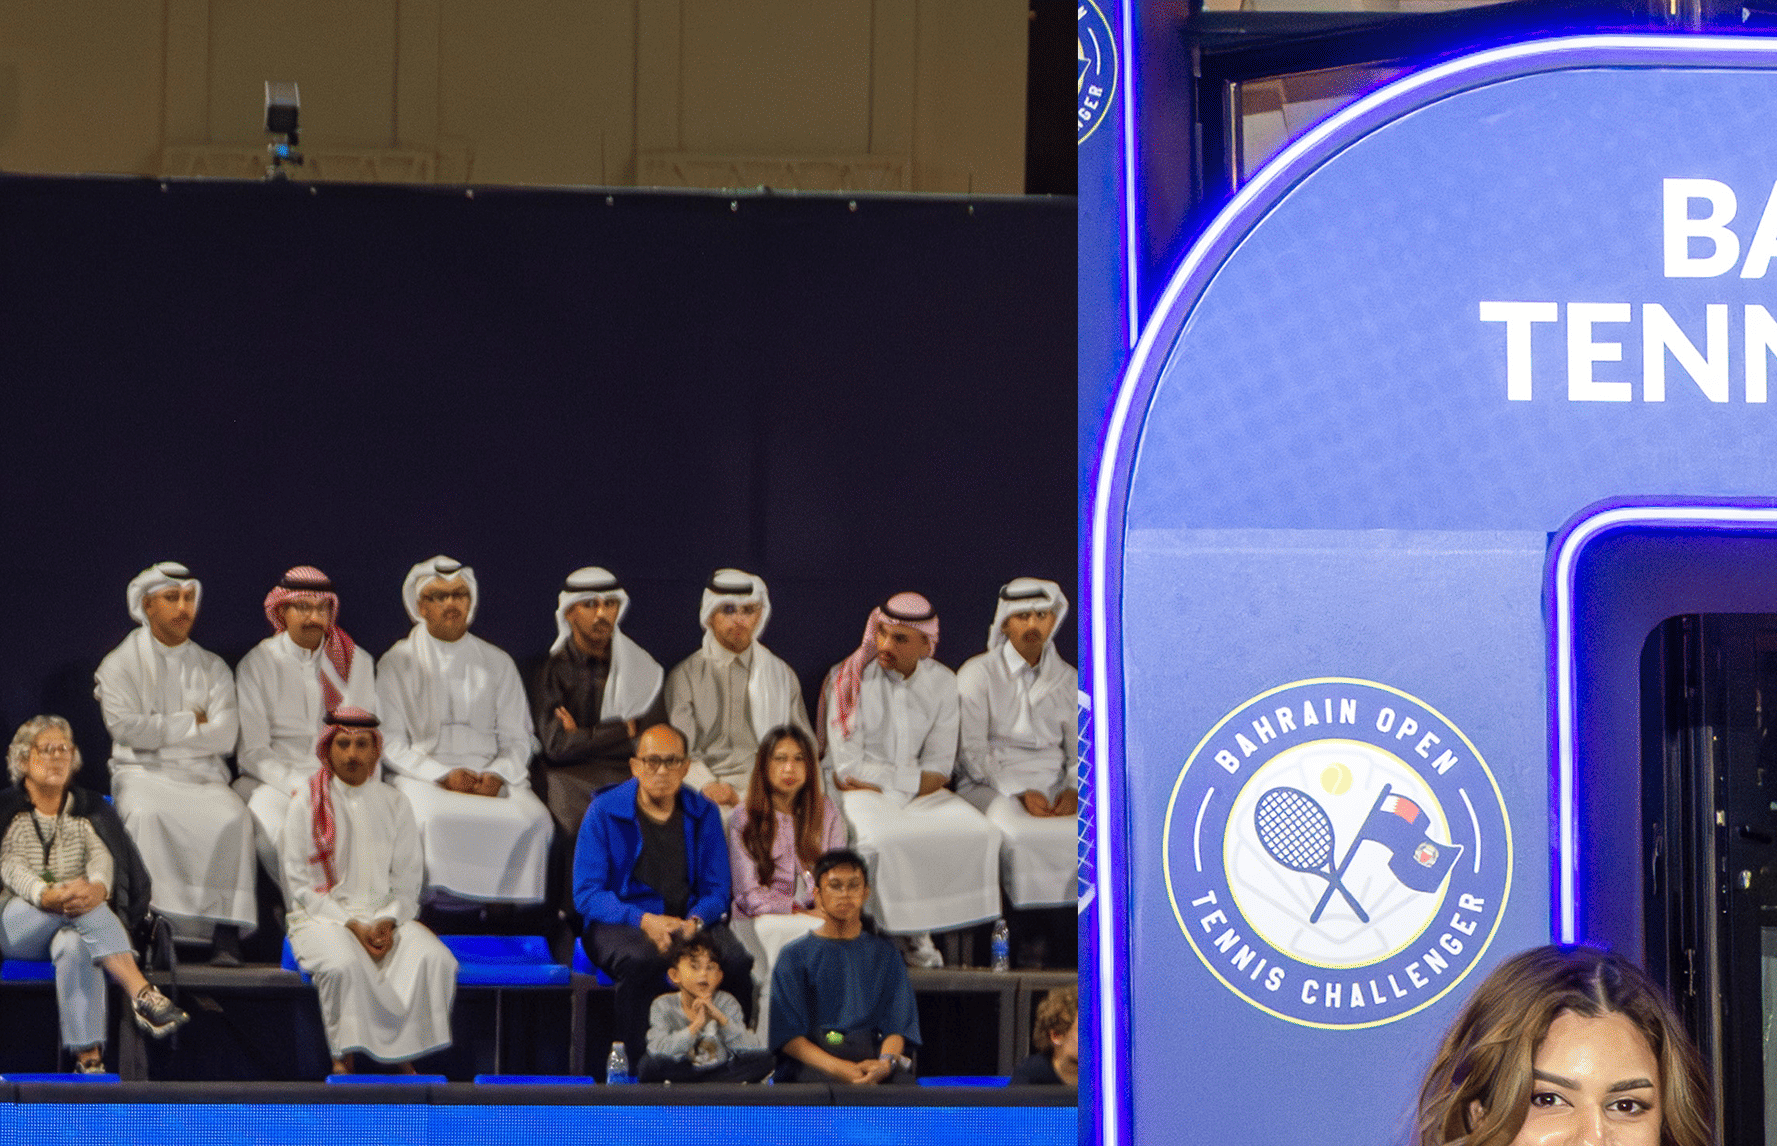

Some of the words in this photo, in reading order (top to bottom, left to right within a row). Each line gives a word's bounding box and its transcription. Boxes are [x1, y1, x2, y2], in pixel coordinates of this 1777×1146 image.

[1214, 698, 1357, 774] BAHRAIN
[1376, 707, 1458, 775] OPEN
[1192, 890, 1286, 992] TENNIS
[1301, 892, 1485, 1008] CHALLENGER
